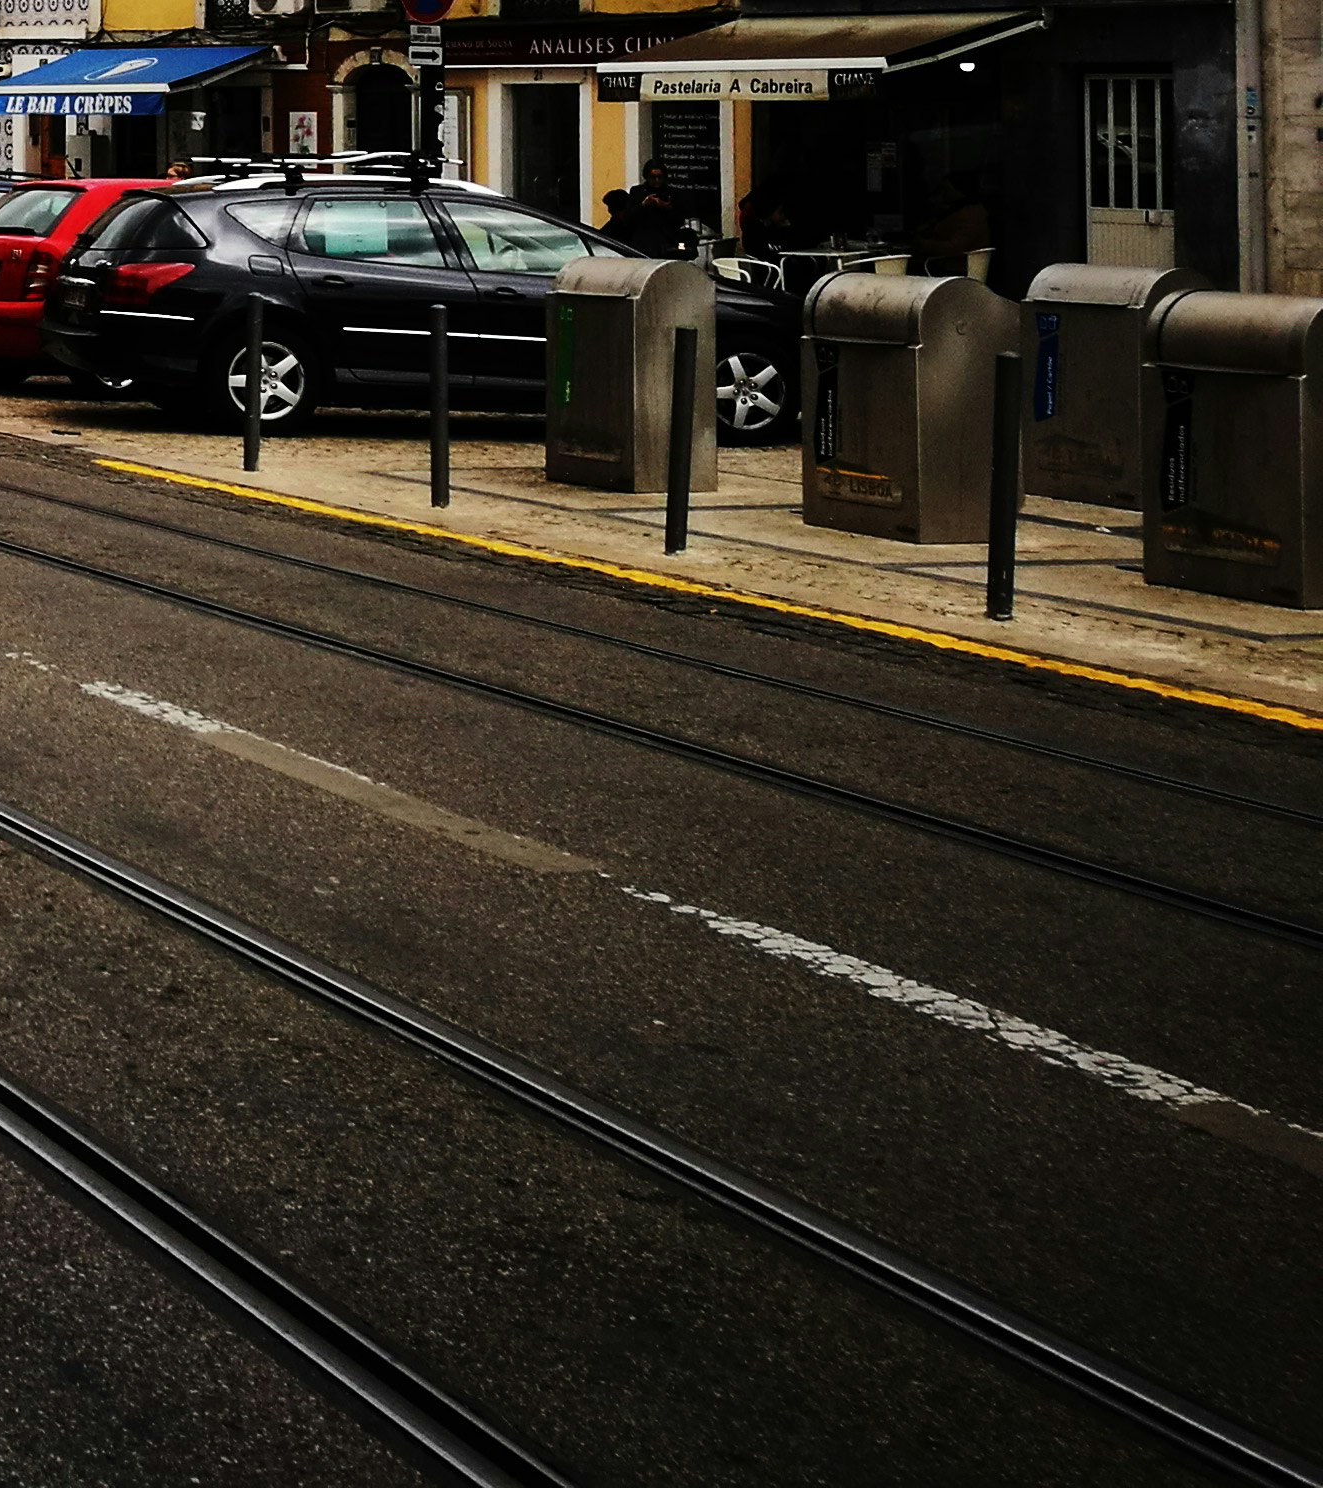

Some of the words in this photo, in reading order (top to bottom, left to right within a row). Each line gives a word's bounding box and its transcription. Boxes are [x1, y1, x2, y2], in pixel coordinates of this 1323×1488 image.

[529, 33, 615, 55] ANÁLISES
[602, 76, 636, 88] CHAVE
[653, 79, 721, 94] Pastelaria
[729, 79, 741, 93] A
[750, 77, 813, 94] Cabreira
[834, 72, 875, 86] CHAVE
[5, 96, 25, 113] LE
[27, 96, 57, 113] BAR
[60, 96, 71, 113] A
[74, 93, 132, 114] CRÊPES
